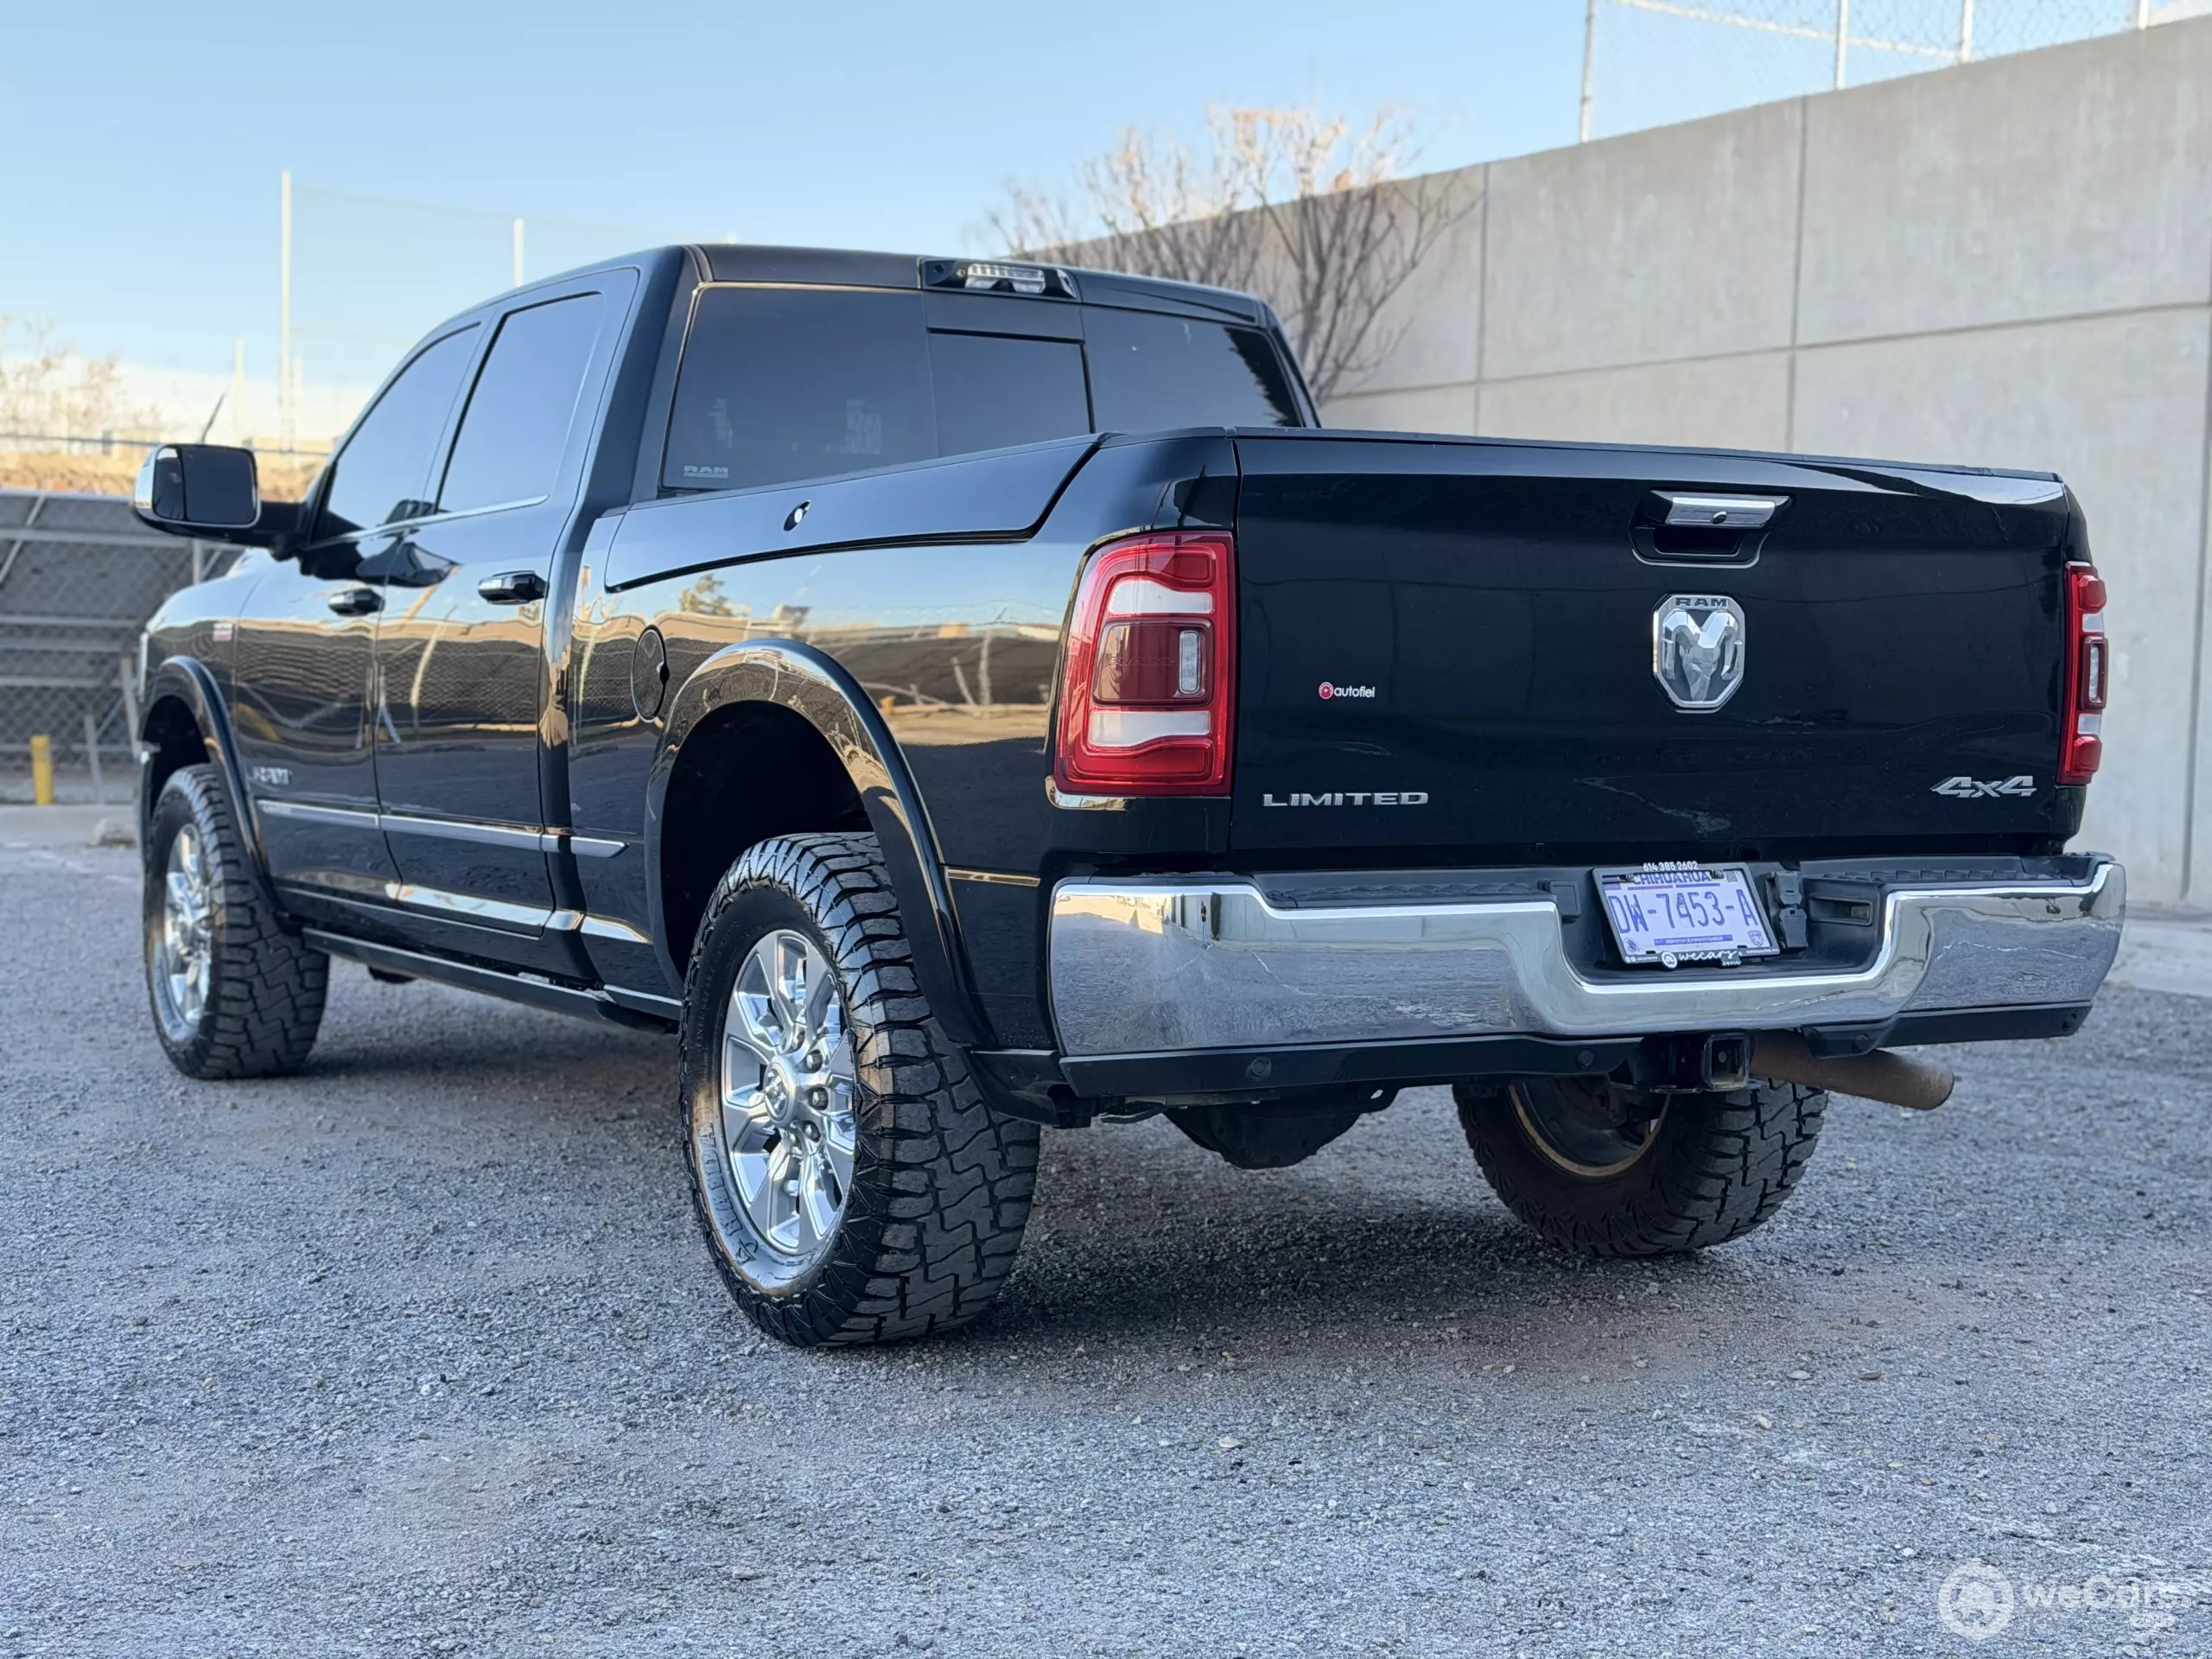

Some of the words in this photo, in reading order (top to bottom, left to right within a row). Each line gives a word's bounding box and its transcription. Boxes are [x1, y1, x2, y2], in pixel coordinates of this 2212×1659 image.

[683, 465, 729, 474] RAM
[1675, 597, 1727, 607] RAM
[1334, 684, 1376, 698] autofiel
[1929, 775, 2037, 798] 4x4
[1262, 791, 1429, 807] LIMITED
[1643, 861, 1657, 872] 614
[1658, 861, 1675, 871] 385
[1676, 860, 1699, 871] 2602
[1633, 871, 1712, 885] CHIHUAHUA
[1608, 888, 1759, 934] DW-7453-A
